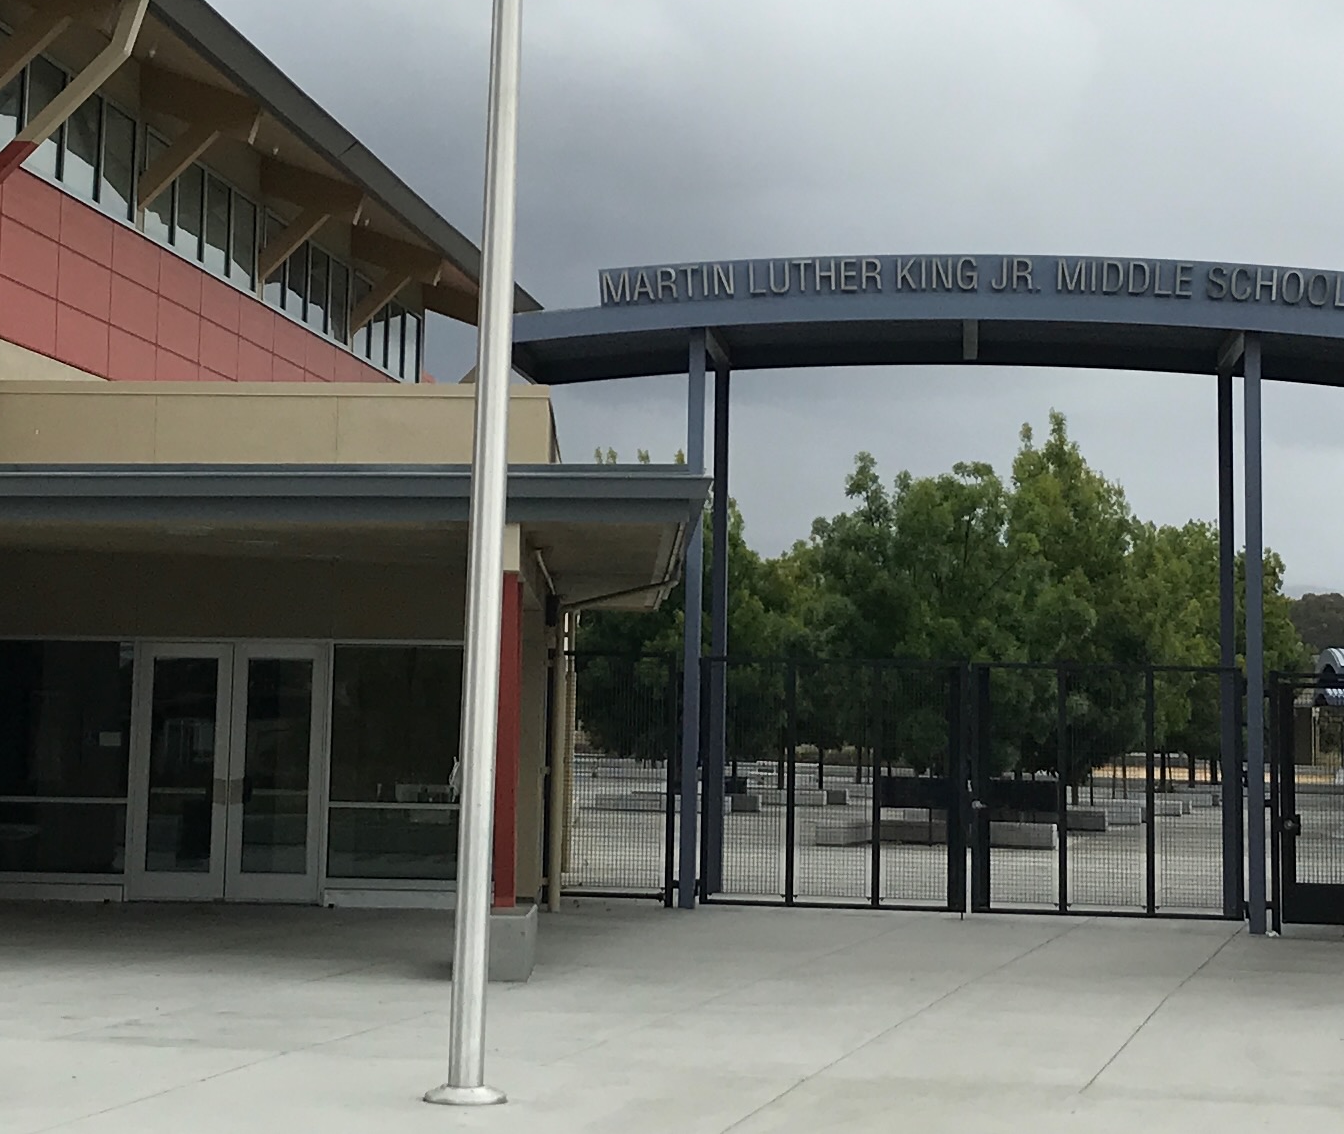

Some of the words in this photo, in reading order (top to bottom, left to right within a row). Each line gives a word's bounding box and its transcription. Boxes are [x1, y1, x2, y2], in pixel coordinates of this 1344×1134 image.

[602, 263, 734, 304] MARTIN
[749, 257, 882, 295] LUTHER
[894, 256, 979, 291] KING
[990, 256, 1042, 293] JR.
[1056, 258, 1194, 298] MIDDLE
